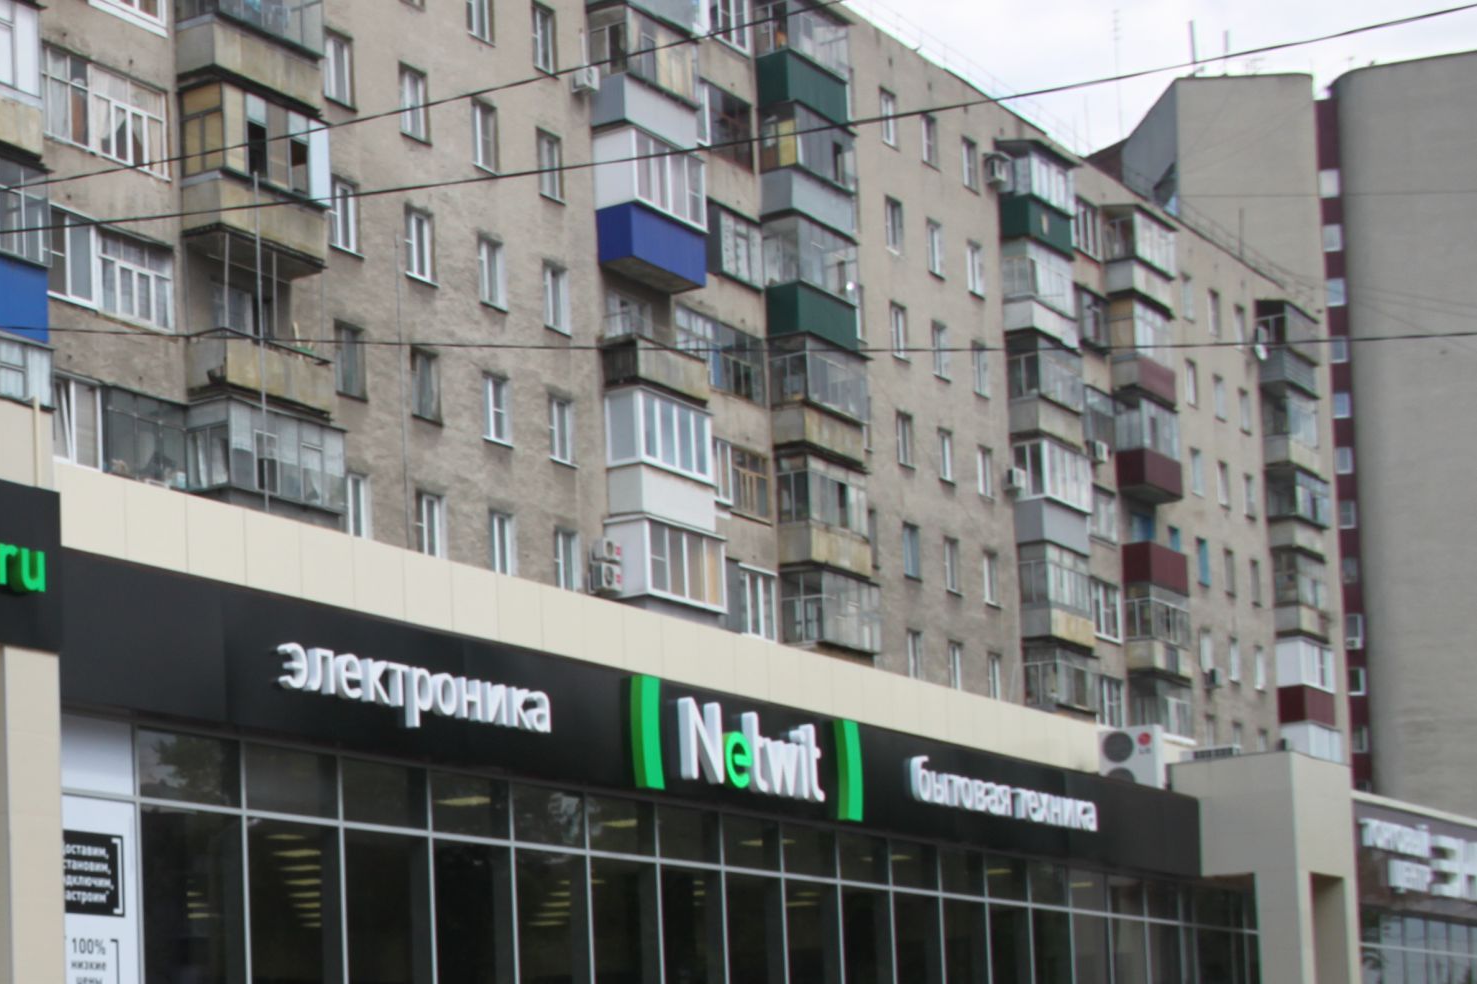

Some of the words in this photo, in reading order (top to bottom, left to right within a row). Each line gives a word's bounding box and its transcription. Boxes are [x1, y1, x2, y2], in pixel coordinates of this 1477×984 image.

[277, 643, 551, 733] электроника
[677, 696, 826, 802] Netwit
[910, 755, 1013, 817] бытовая
[1011, 787, 1098, 832] техника
[62, 843, 109, 859] оставим,
[71, 961, 106, 971] низкие
[72, 938, 106, 955] 100%
